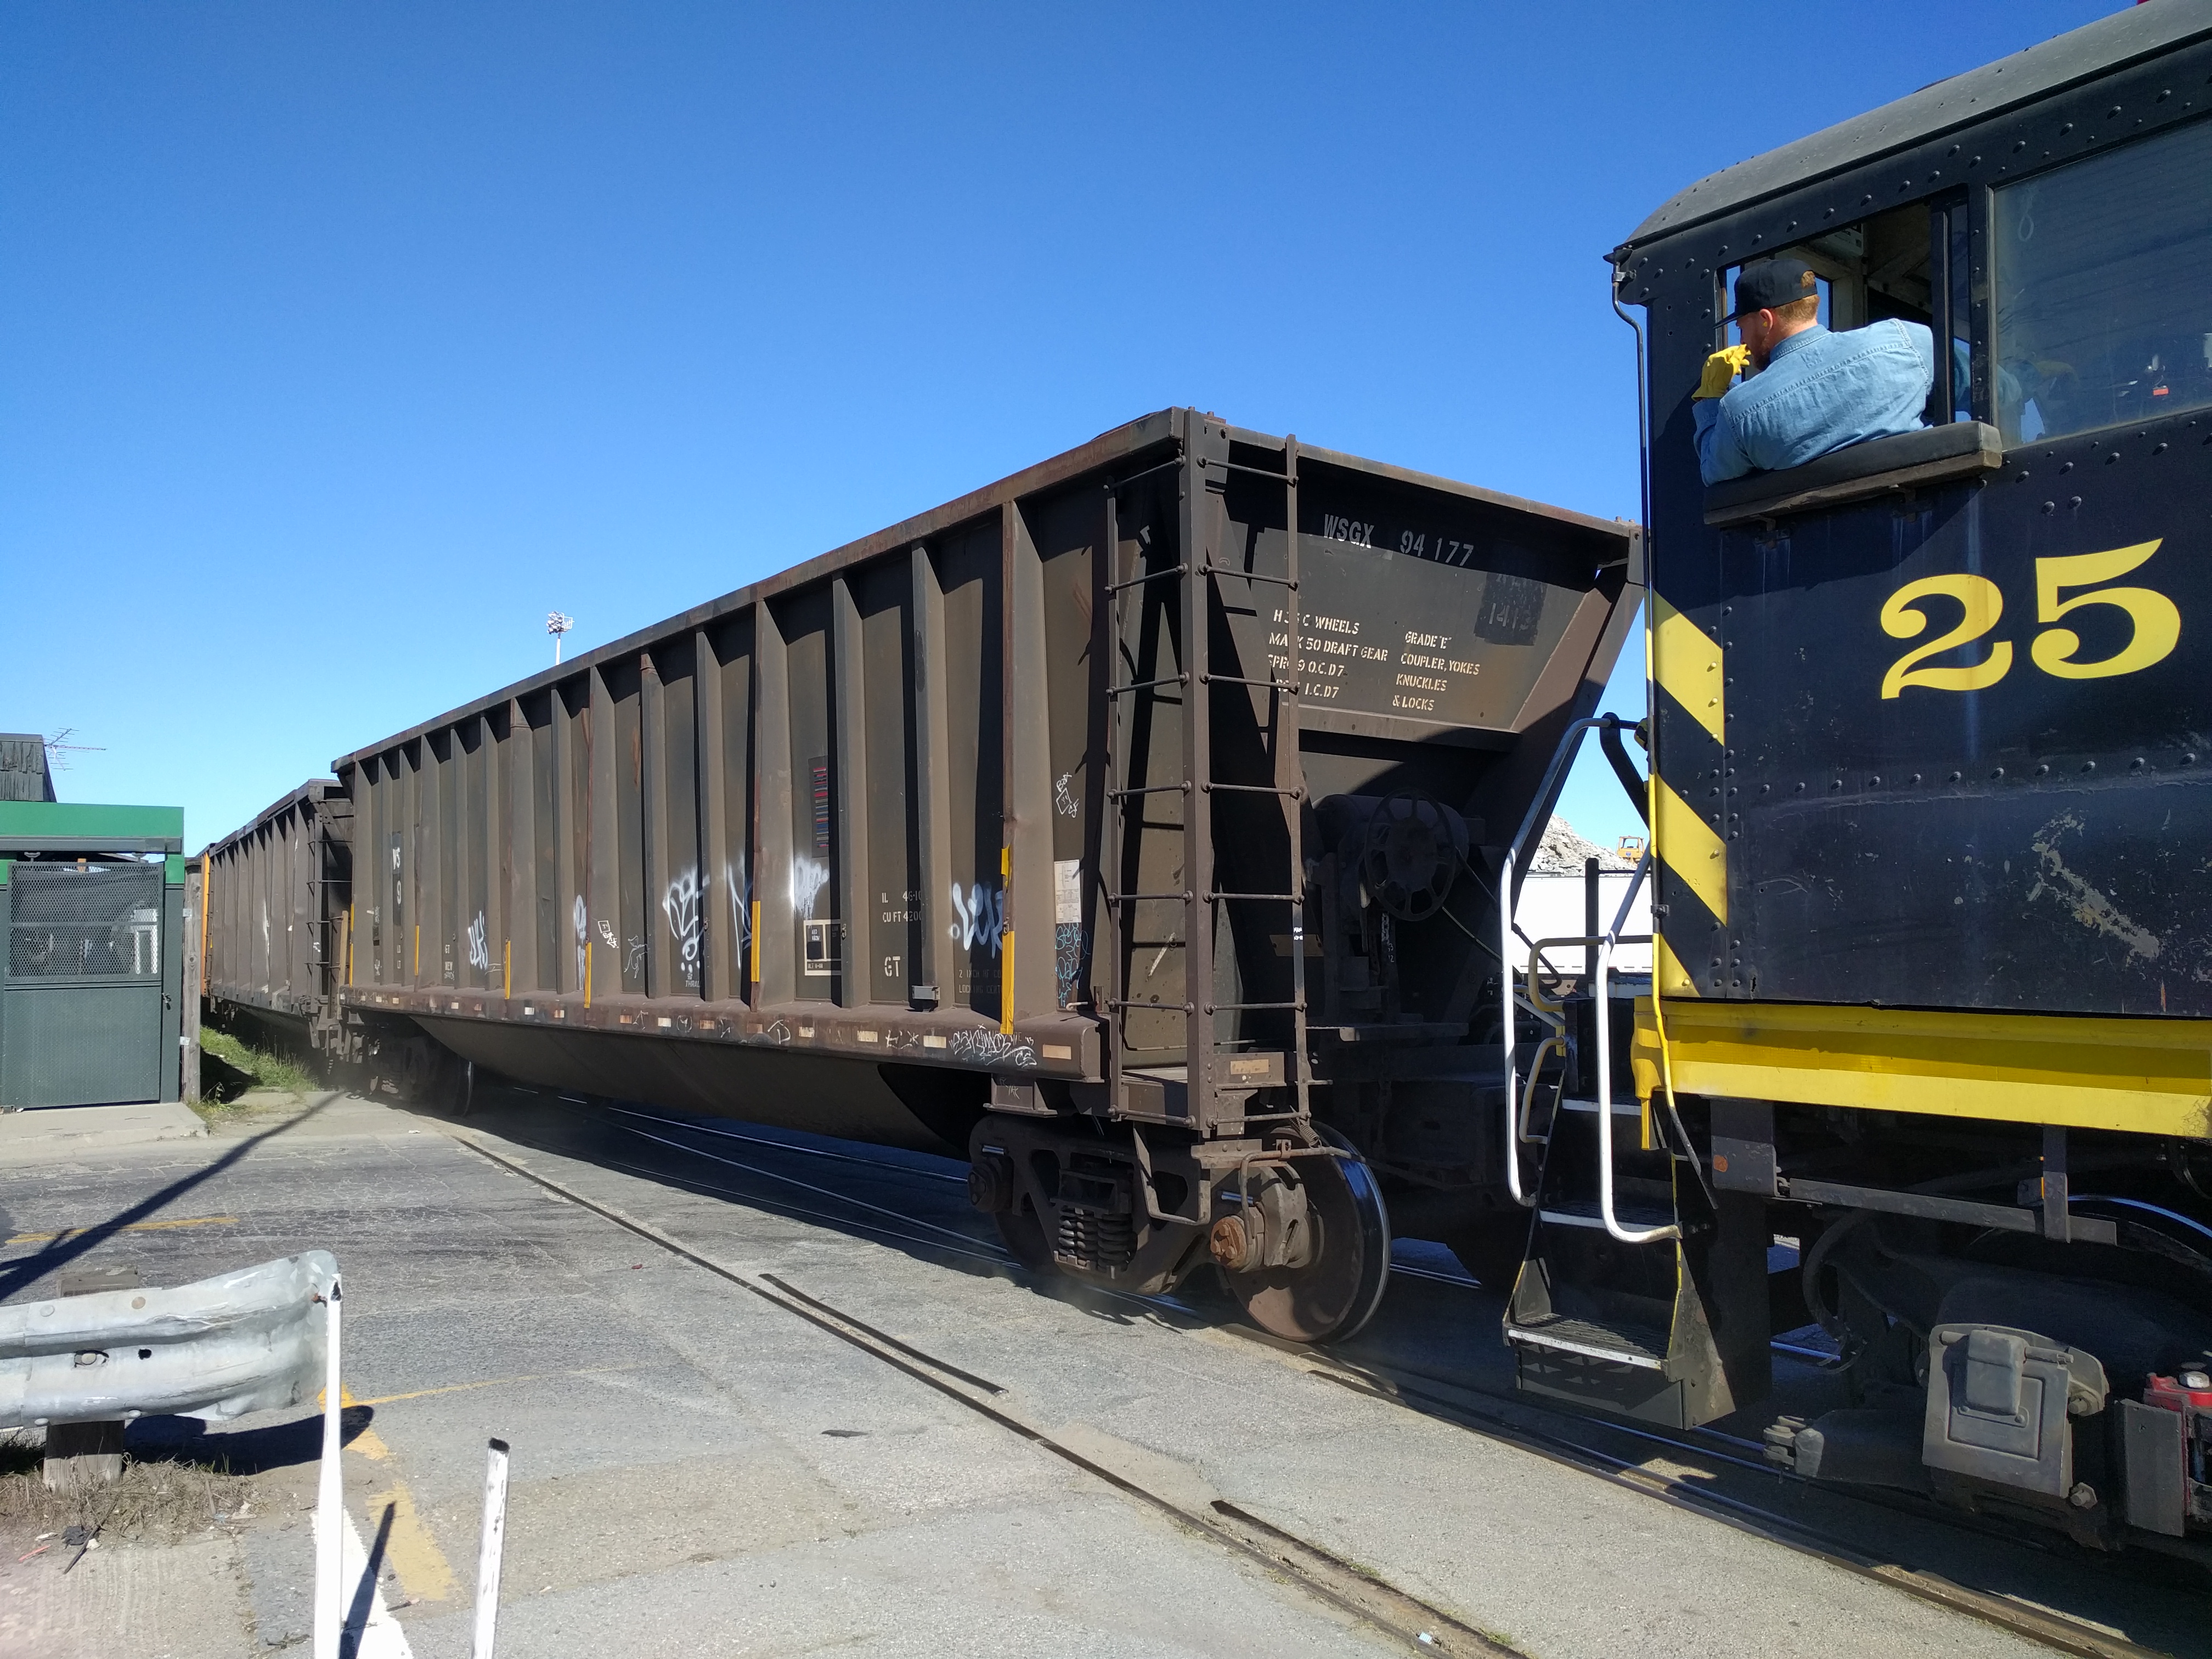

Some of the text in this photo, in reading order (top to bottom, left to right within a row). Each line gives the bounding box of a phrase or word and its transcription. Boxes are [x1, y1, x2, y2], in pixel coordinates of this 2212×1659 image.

[1323, 514, 1374, 549] WSGX
[1315, 616, 1360, 635] WHEELS
[1880, 537, 2181, 699] 25
[1269, 632, 1389, 662] MAK 50 DRAFT GEAR
[1405, 631, 1437, 647] GRADE
[1448, 659, 1480, 675] YOKES
[1396, 673, 1447, 691] KNUCKLES
[1392, 695, 1435, 711] & LOCKS
[882, 893, 889, 903] IL
[882, 912, 891, 923] CU
[893, 911, 901, 922] FT
[884, 956, 901, 977] GT
[959, 969, 963, 978] 2
